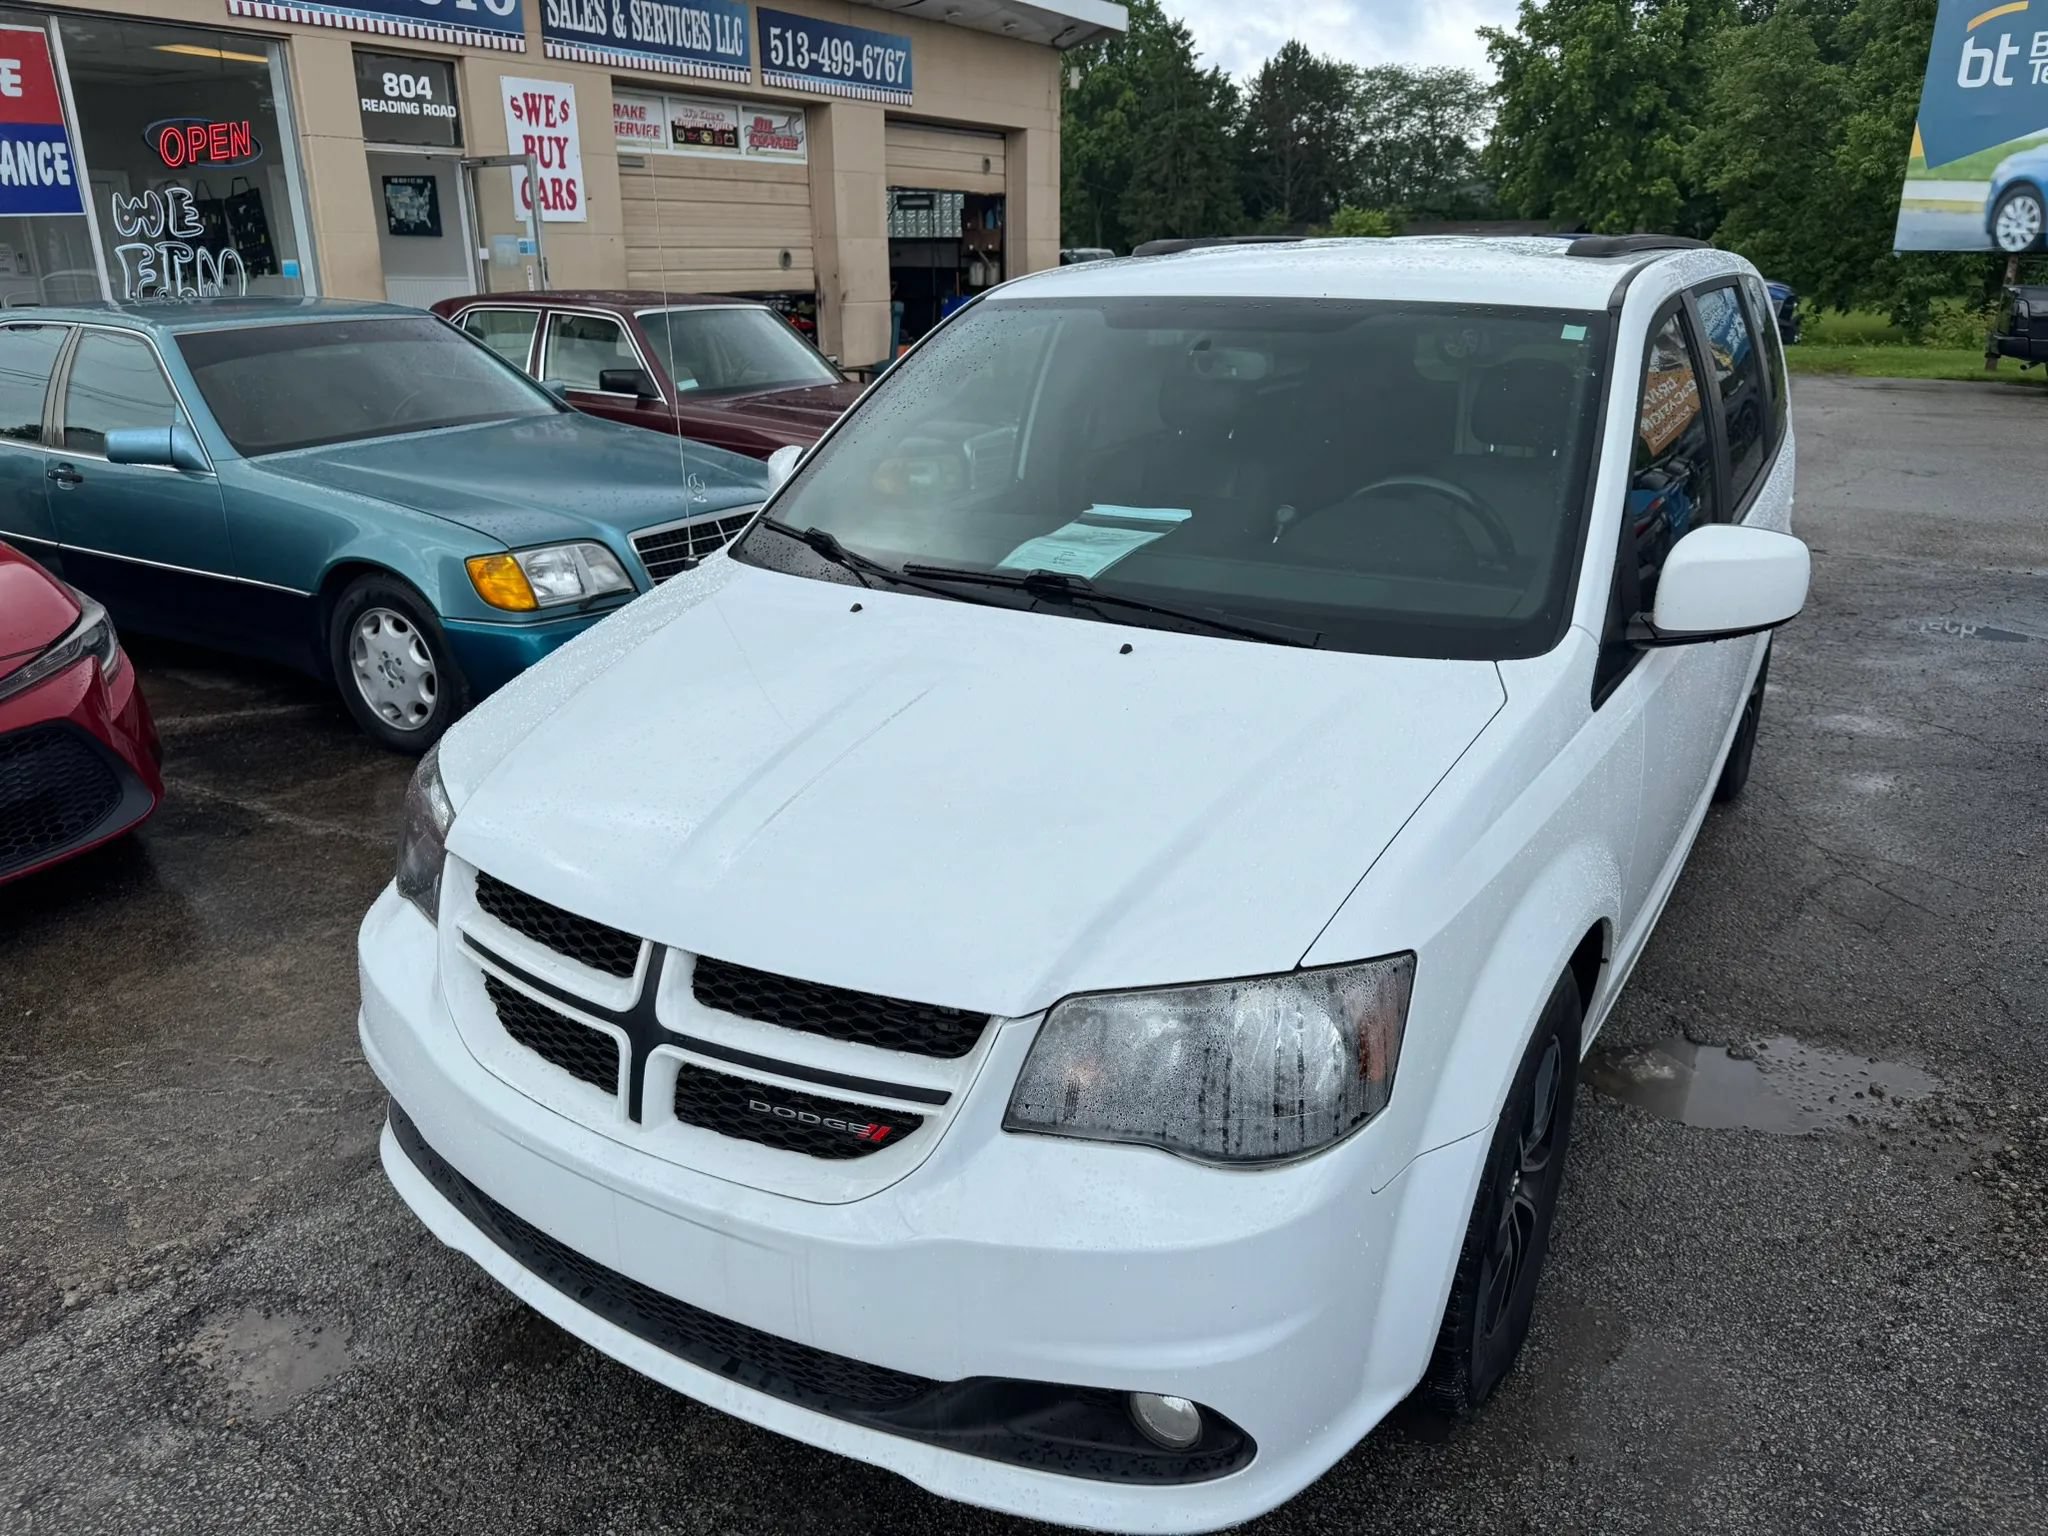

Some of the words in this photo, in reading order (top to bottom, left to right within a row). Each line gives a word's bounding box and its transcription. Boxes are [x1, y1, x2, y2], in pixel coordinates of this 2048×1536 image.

[547, 0, 608, 36] SALES
[612, 0, 628, 39] &
[631, 0, 712, 52] SERVICES
[714, 13, 744, 57] LLC
[769, 26, 907, 84] 513-499-6767
[1957, 33, 2020, 89] bt
[382, 72, 433, 100] 804
[361, 98, 420, 116] READING
[422, 103, 457, 118] ROAD
[159, 120, 252, 168] OPEN
[522, 134, 569, 170] BUY
[112, 187, 204, 238] WE
[521, 177, 578, 211] CARS
[750, 1099, 871, 1137] DODGE
